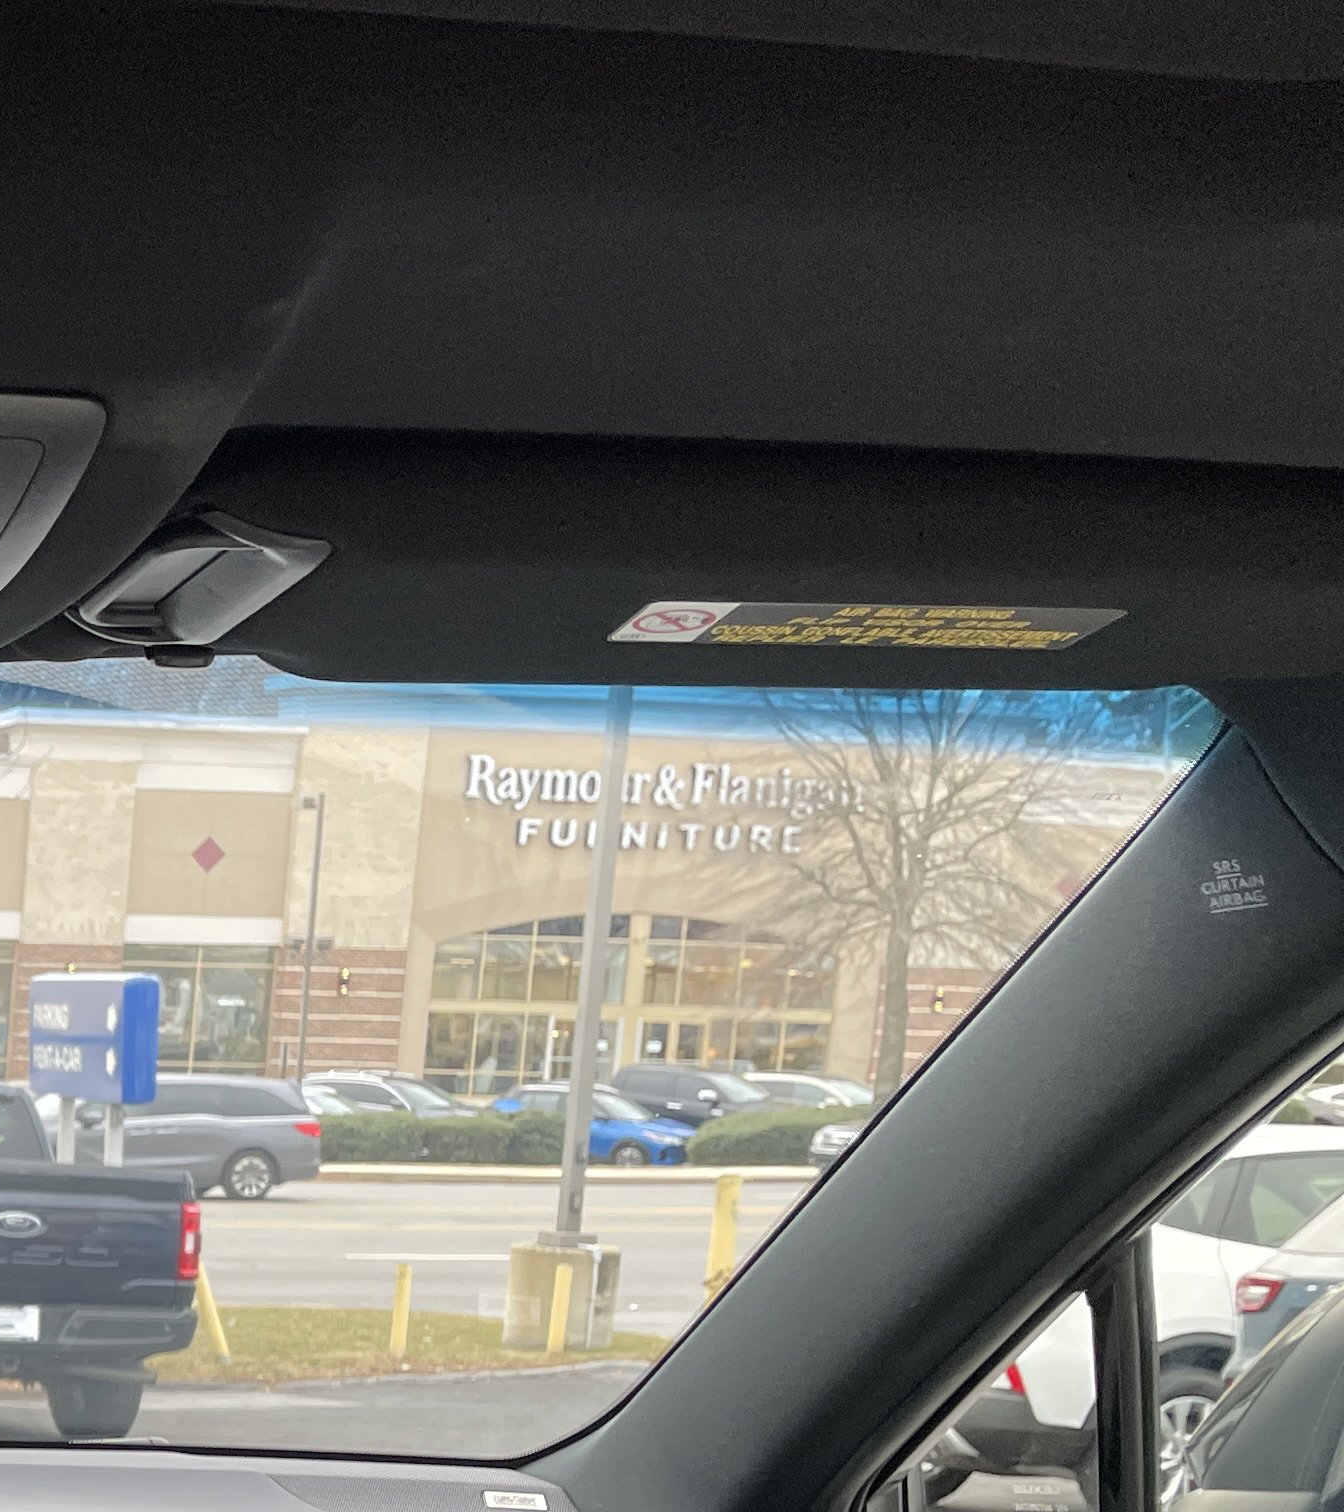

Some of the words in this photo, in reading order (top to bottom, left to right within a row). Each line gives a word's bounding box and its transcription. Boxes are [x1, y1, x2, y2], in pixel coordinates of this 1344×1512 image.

[710, 625, 798, 635] COUSSIN
[465, 753, 651, 811] Raymor
[518, 817, 804, 854] FUNITURE
[1212, 859, 1241, 875] SRS
[1200, 874, 1265, 896] CURTAIN
[1209, 889, 1269, 909] AIRBAG
